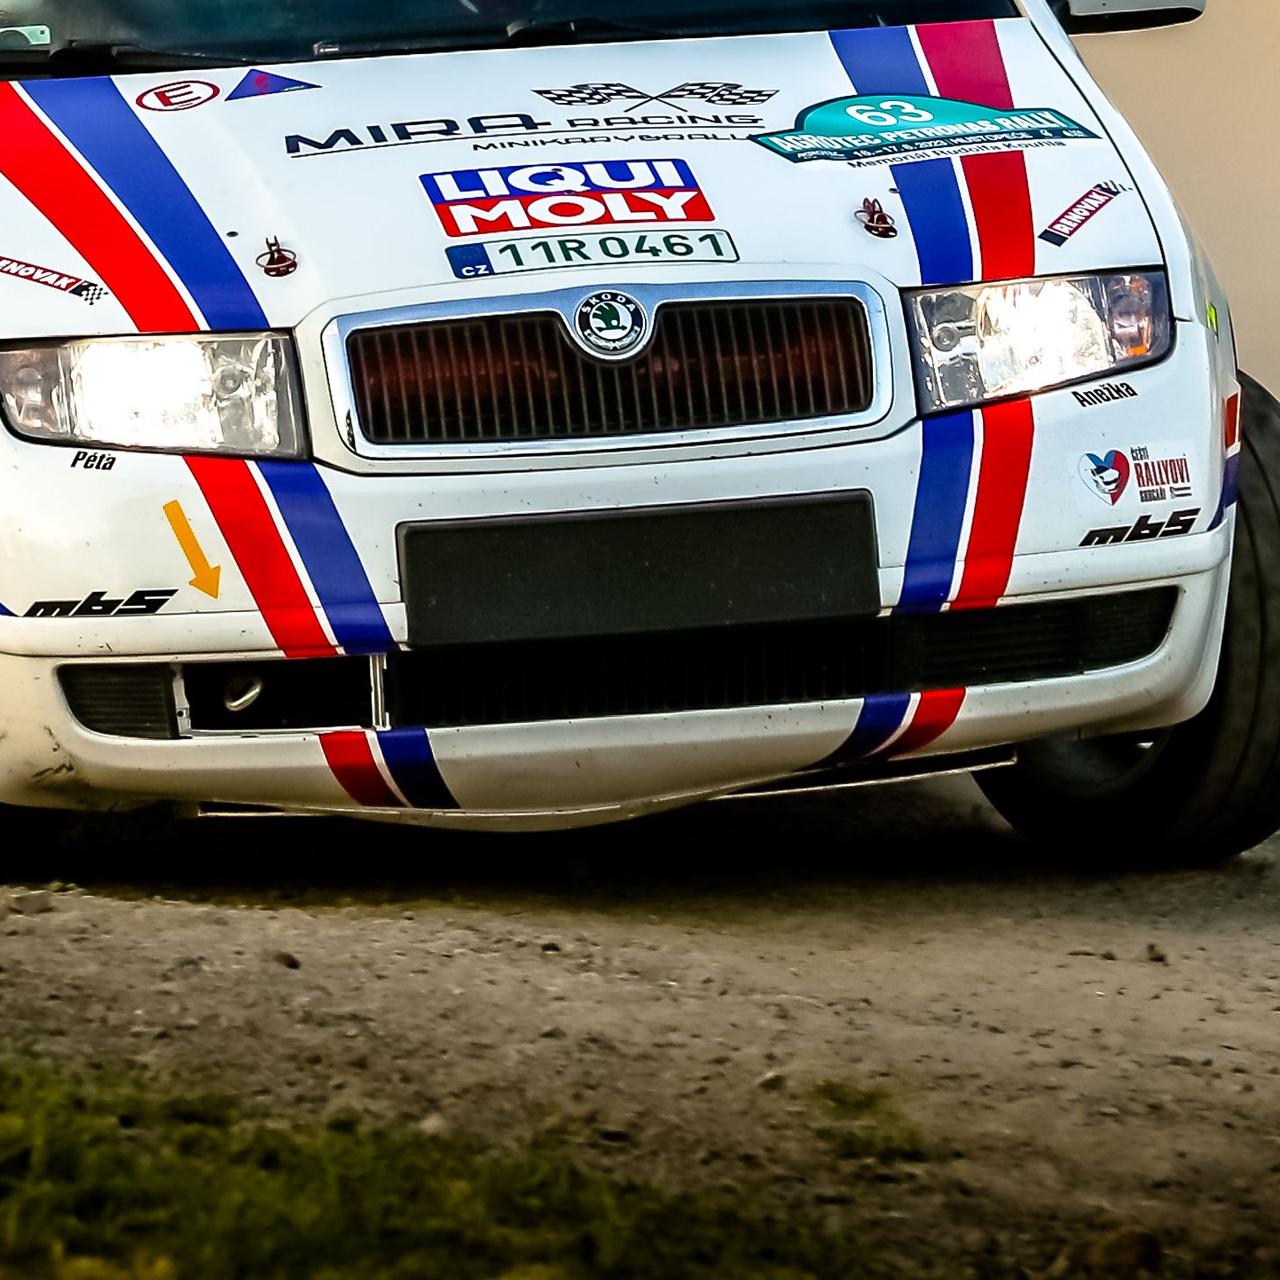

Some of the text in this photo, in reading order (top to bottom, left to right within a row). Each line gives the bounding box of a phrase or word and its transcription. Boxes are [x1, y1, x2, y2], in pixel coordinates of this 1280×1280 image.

[153, 83, 202, 107] E
[845, 100, 934, 127] 63
[284, 112, 764, 154] MIRA RACING
[768, 111, 1068, 152] AGROTEC PETRONAS RALLY
[434, 160, 689, 202] LIQUI
[446, 189, 701, 234] MOLY
[1056, 190, 1109, 237] RENOVAK
[461, 233, 725, 277] CZ 11R 0461
[1071, 380, 1138, 408] Anežka
